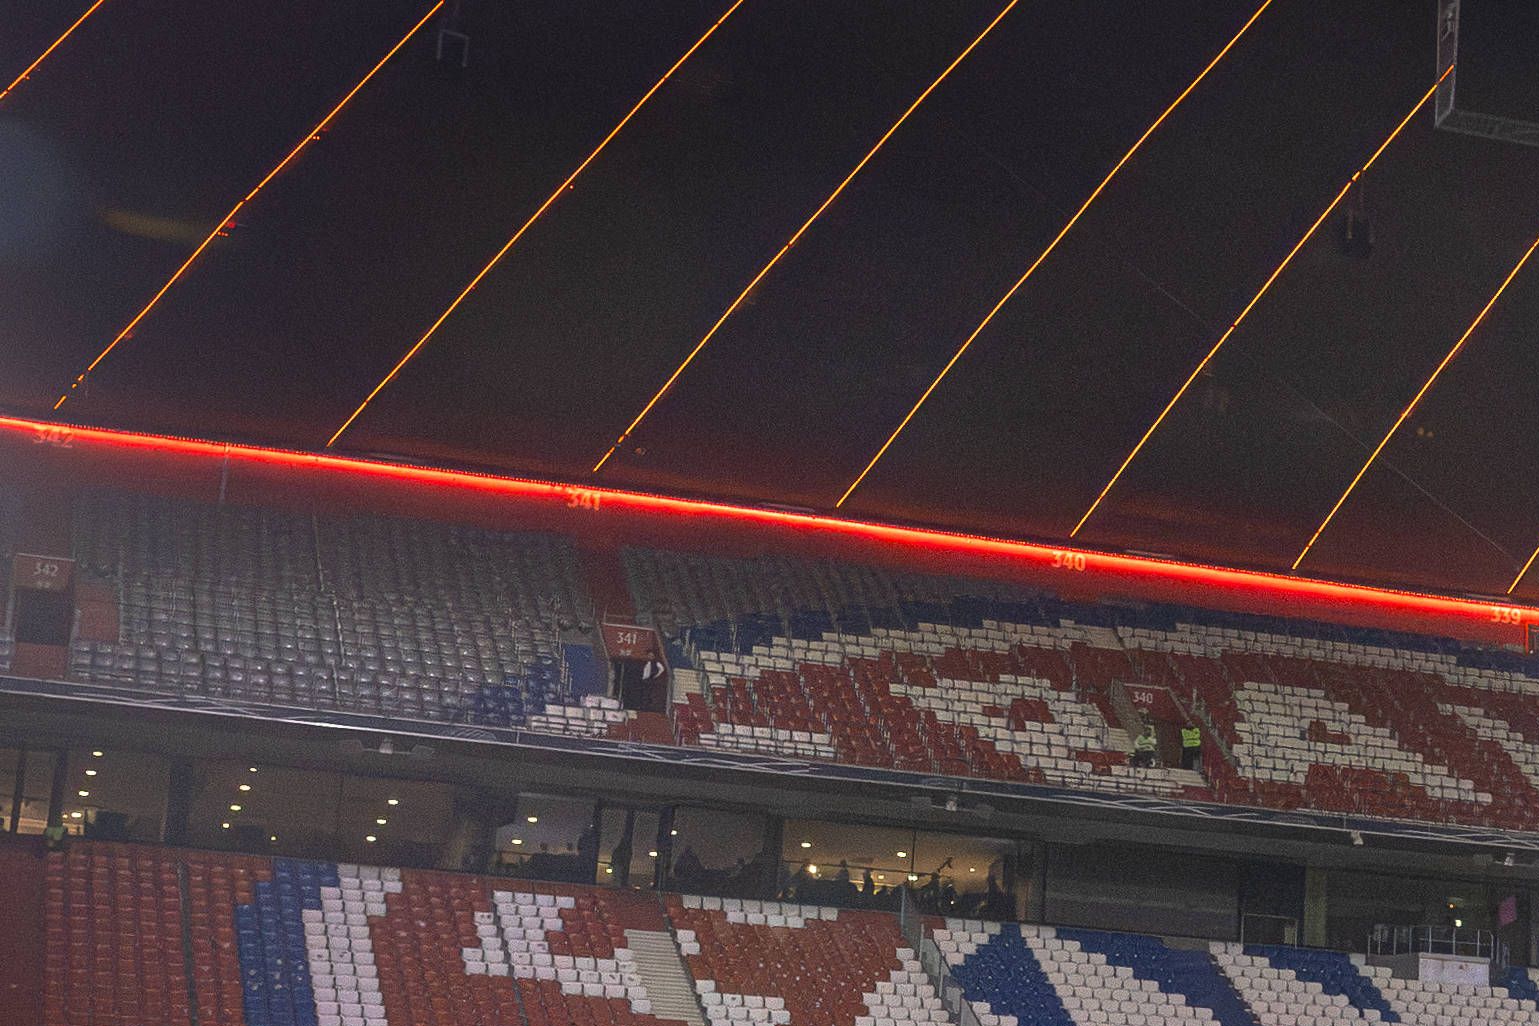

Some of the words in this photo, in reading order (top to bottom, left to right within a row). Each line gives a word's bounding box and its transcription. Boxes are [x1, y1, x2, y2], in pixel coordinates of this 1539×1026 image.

[567, 489, 600, 511] 341
[1052, 552, 1086, 572] 340
[33, 563, 59, 577] 342
[1490, 608, 1521, 625] 339
[616, 632, 637, 645] 341
[1133, 692, 1153, 704] 340
